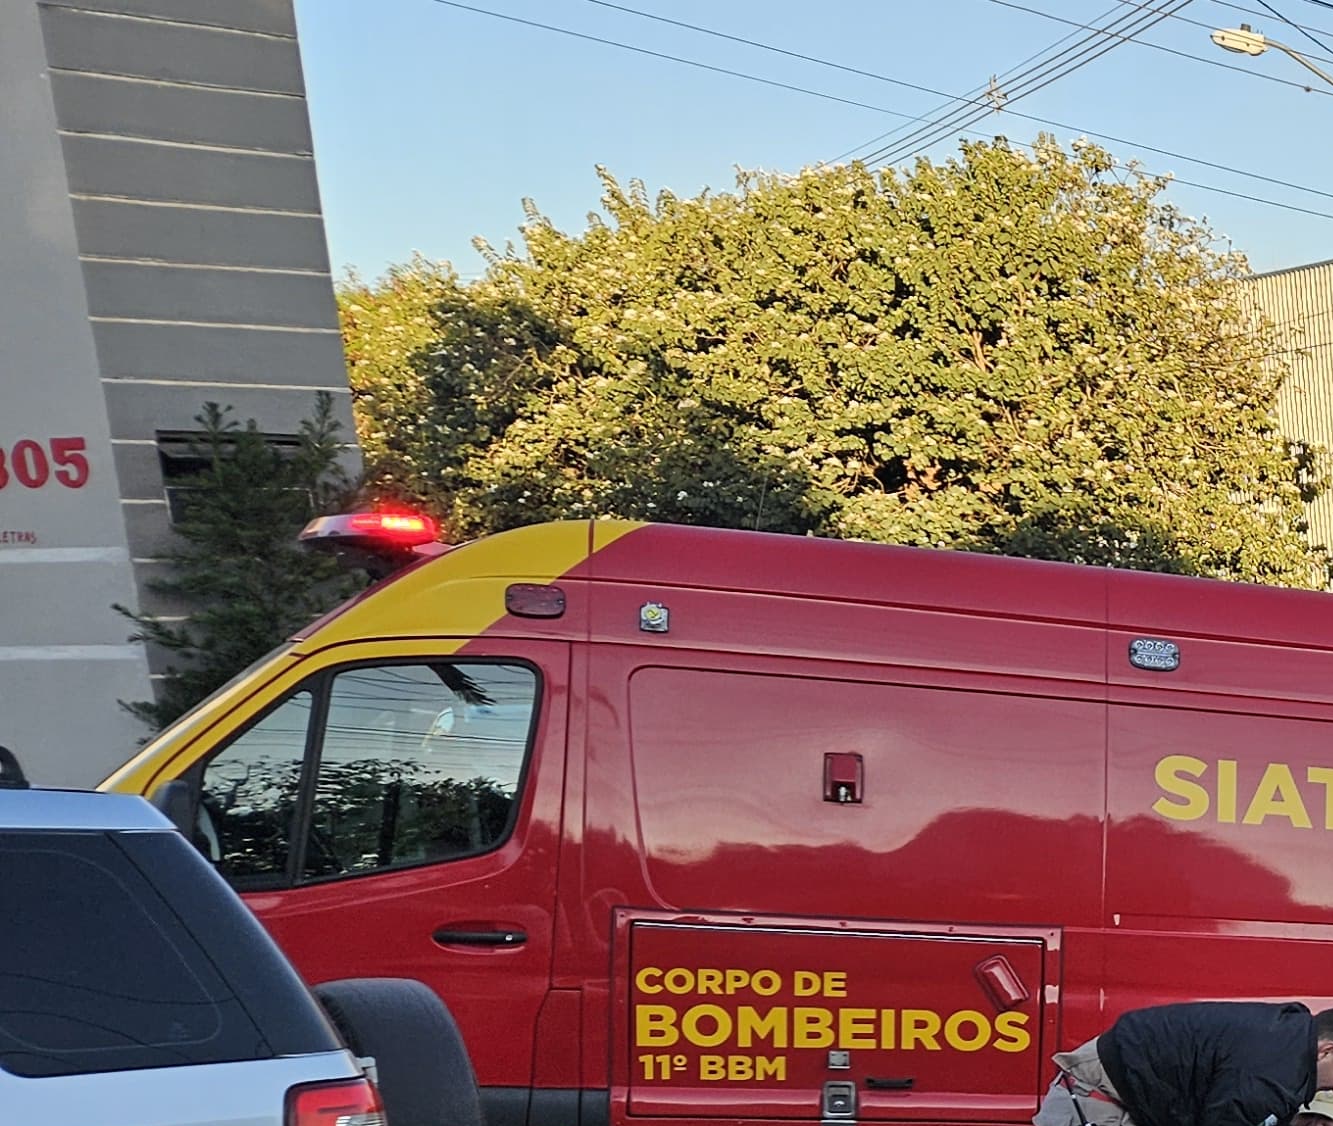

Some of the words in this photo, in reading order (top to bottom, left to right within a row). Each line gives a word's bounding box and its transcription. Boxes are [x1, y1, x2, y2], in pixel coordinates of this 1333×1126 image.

[635, 967, 782, 996] CORPO
[794, 971, 847, 998] DE
[635, 1004, 1031, 1052] BOMBEIROS
[699, 1055, 787, 1081] BBM
